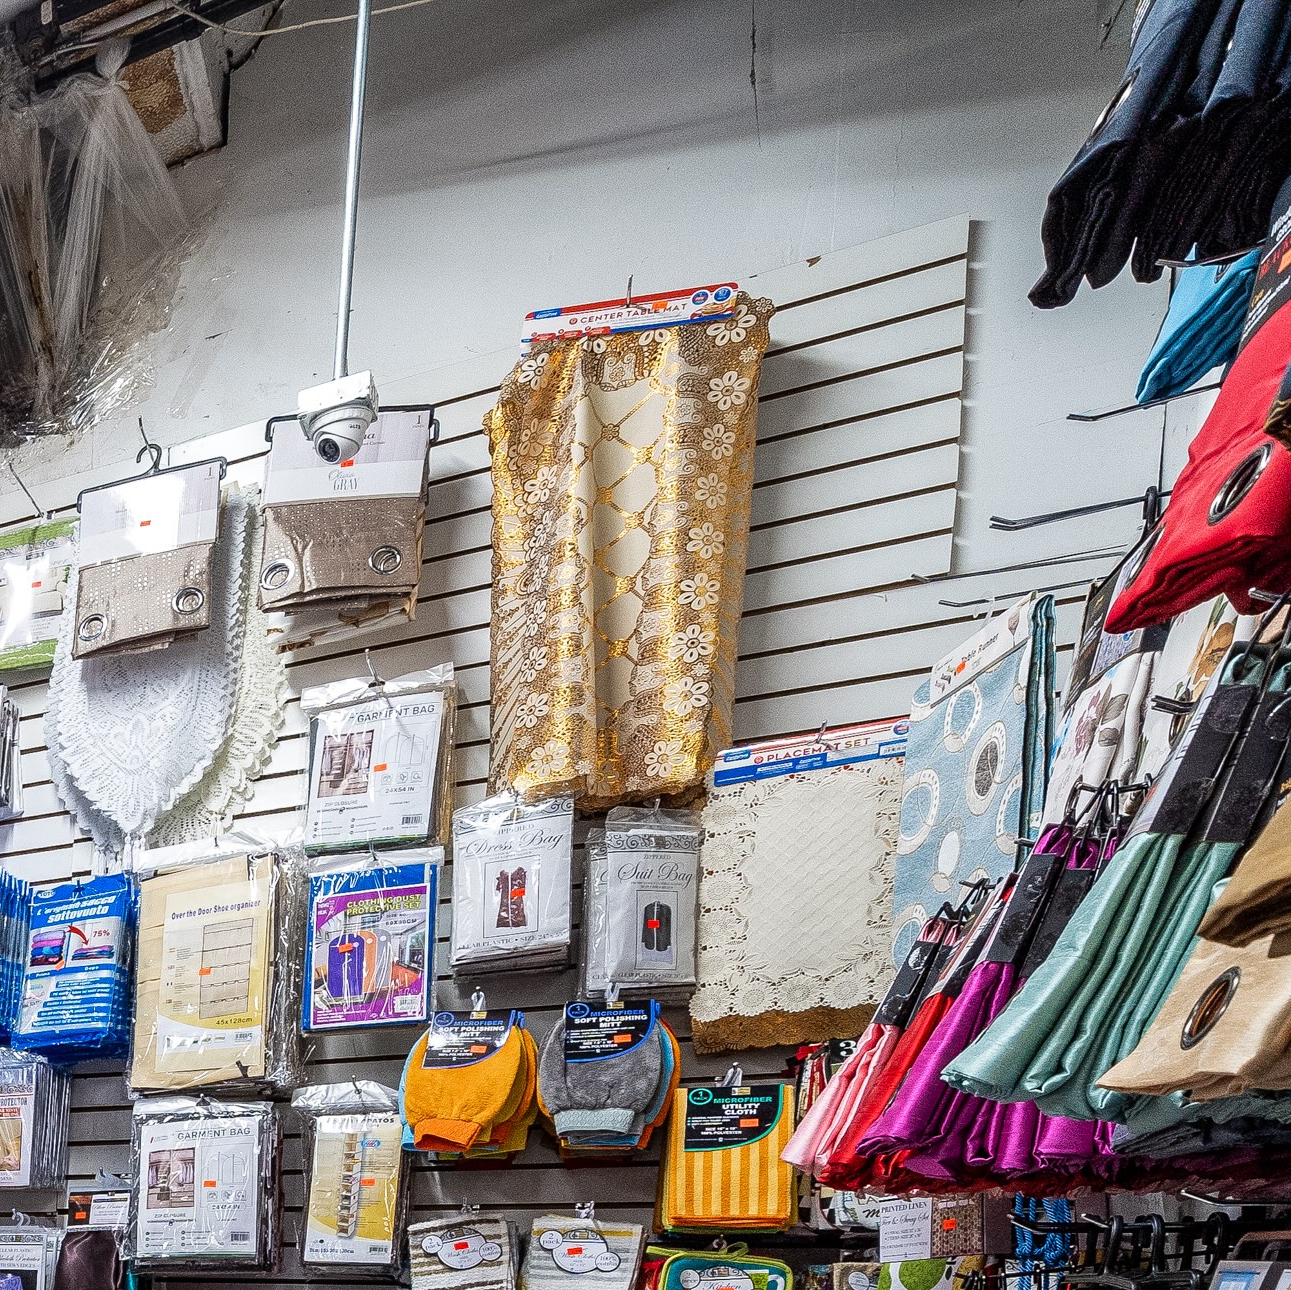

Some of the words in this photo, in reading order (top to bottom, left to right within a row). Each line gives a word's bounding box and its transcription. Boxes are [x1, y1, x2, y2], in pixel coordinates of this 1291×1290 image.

[579, 310, 623, 326] CENTER
[626, 306, 660, 321] TABLE
[663, 301, 687, 315] MAT
[411, 703, 436, 716] BAG
[766, 742, 838, 763] PLACEMAT
[840, 736, 871, 751] SET
[465, 837, 522, 858] Dress
[528, 831, 564, 852] Bag
[616, 861, 653, 882] Suit
[657, 865, 695, 889] Bag
[171, 912, 186, 921] Over
[186, 910, 197, 918] the
[198, 906, 214, 916] Door
[214, 904, 229, 913] Shoe
[230, 900, 261, 912] organizer
[92, 929, 111, 938] 75%
[591, 1008, 645, 1018] MICROFIBER
[595, 1013, 647, 1022] POLISHING
[438, 1025, 458, 1033] SOFT
[460, 1023, 506, 1032] POLISHING
[453, 1019, 505, 1027] MICROFIBER
[460, 1030, 481, 1038] MITT
[713, 1096, 772, 1104] MICROFIBER
[177, 1129, 225, 1140] GARMENT
[229, 1127, 251, 1137] BAG
